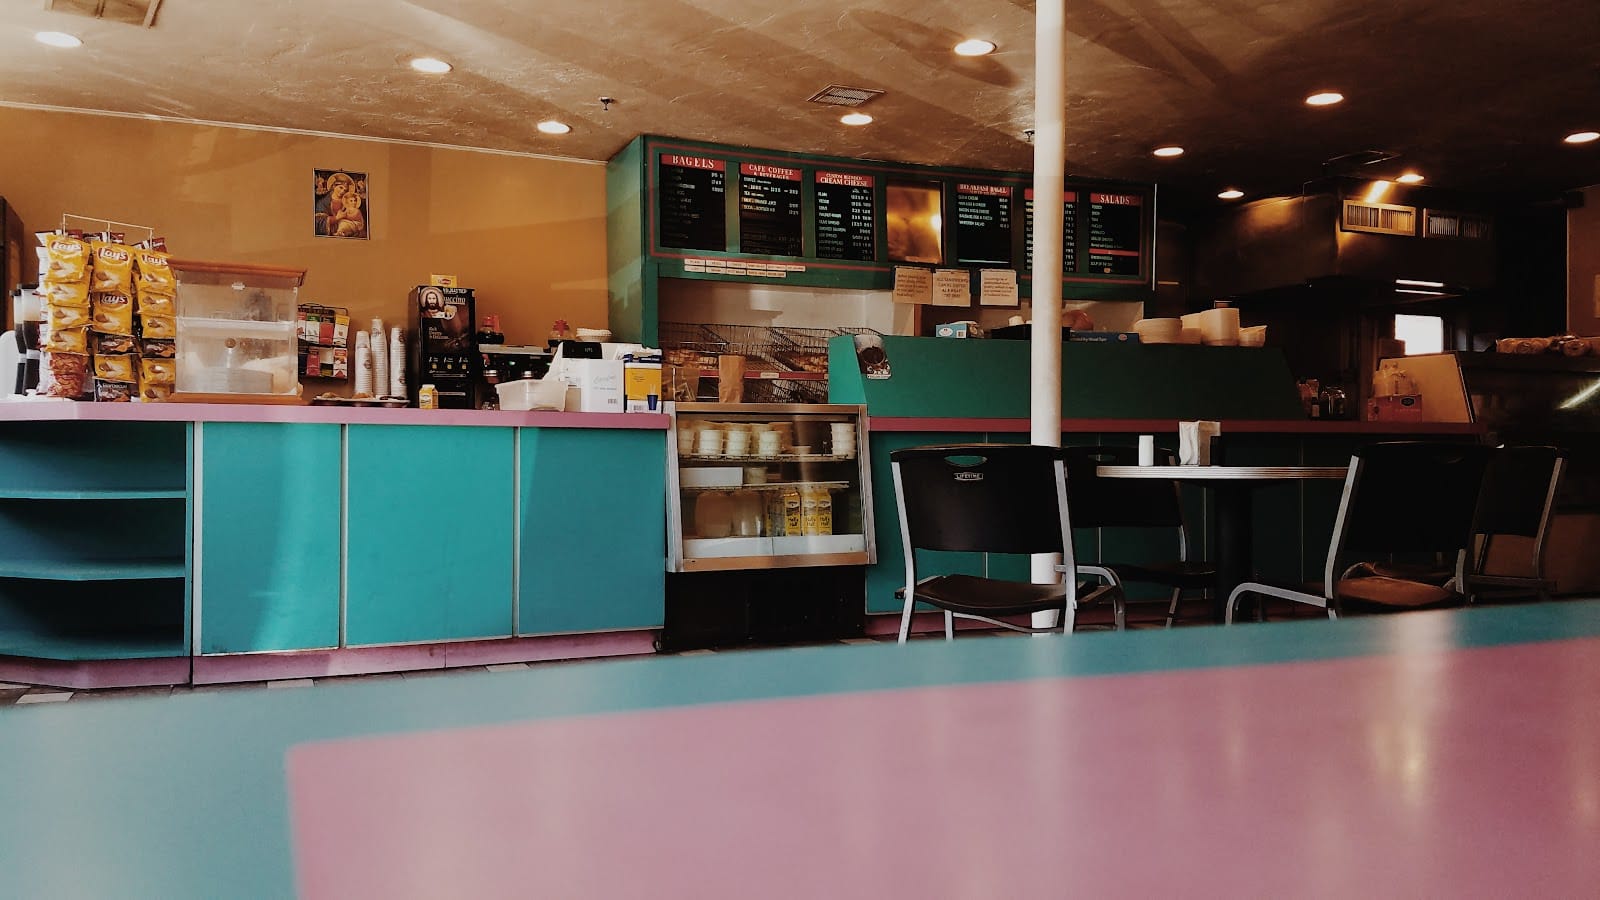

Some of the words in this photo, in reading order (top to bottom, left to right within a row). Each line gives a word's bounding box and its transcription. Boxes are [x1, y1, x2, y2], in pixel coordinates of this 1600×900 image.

[672, 155, 714, 169] BAGELS
[749, 164, 766, 173] CAFE
[768, 166, 794, 176] COFFEE
[759, 172, 790, 180] BEVERAGES
[820, 177, 843, 185] CREAM
[844, 179, 868, 188] CHEESE
[959, 184, 989, 192] BREAKFAST
[989, 185, 1008, 194] BAGEL
[1100, 194, 1130, 205] SALADS
[100, 248, 128, 260] Lay's
[101, 294, 128, 304] Lay's
